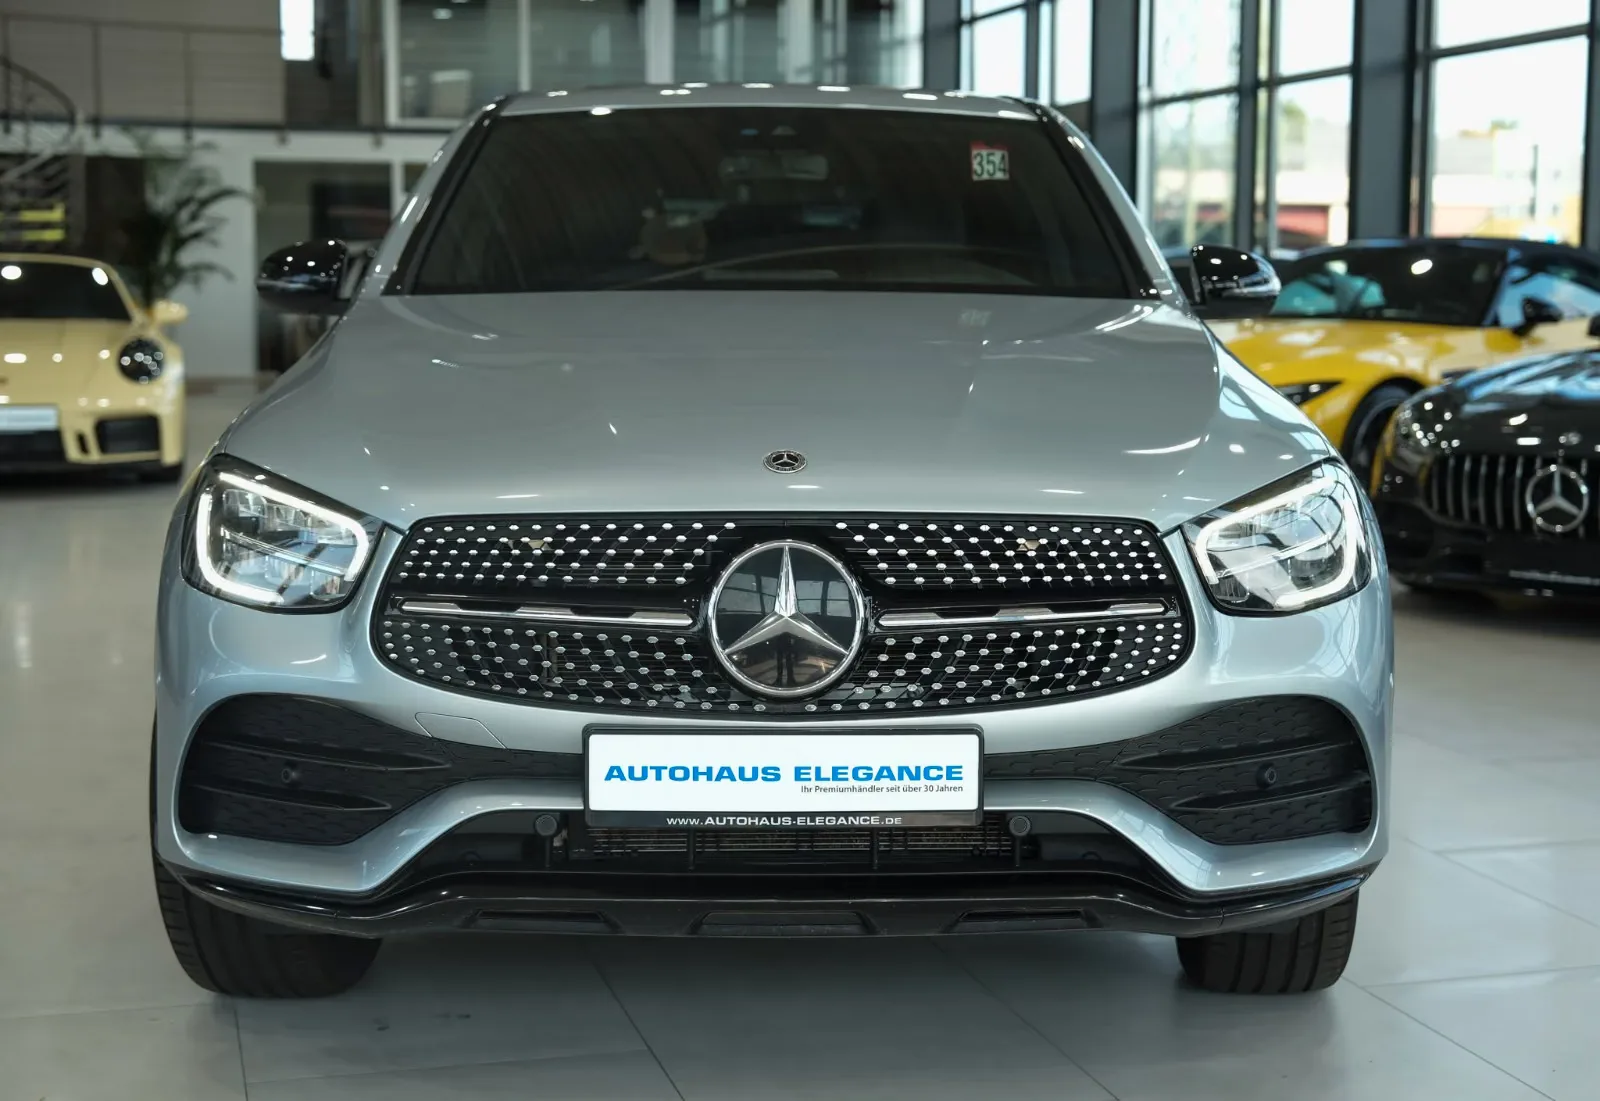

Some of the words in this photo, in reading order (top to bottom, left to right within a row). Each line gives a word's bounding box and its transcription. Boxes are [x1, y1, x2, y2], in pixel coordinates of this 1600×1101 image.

[974, 151, 1007, 178] 354
[604, 765, 782, 783] AUTOHAUS
[793, 765, 964, 782] ELEGANCE
[800, 784, 812, 793] Ihr
[814, 784, 884, 793] Premiumhändler
[886, 784, 901, 793] seit
[902, 784, 922, 793] über
[923, 784, 934, 793] 30
[935, 784, 964, 793] Jahren
